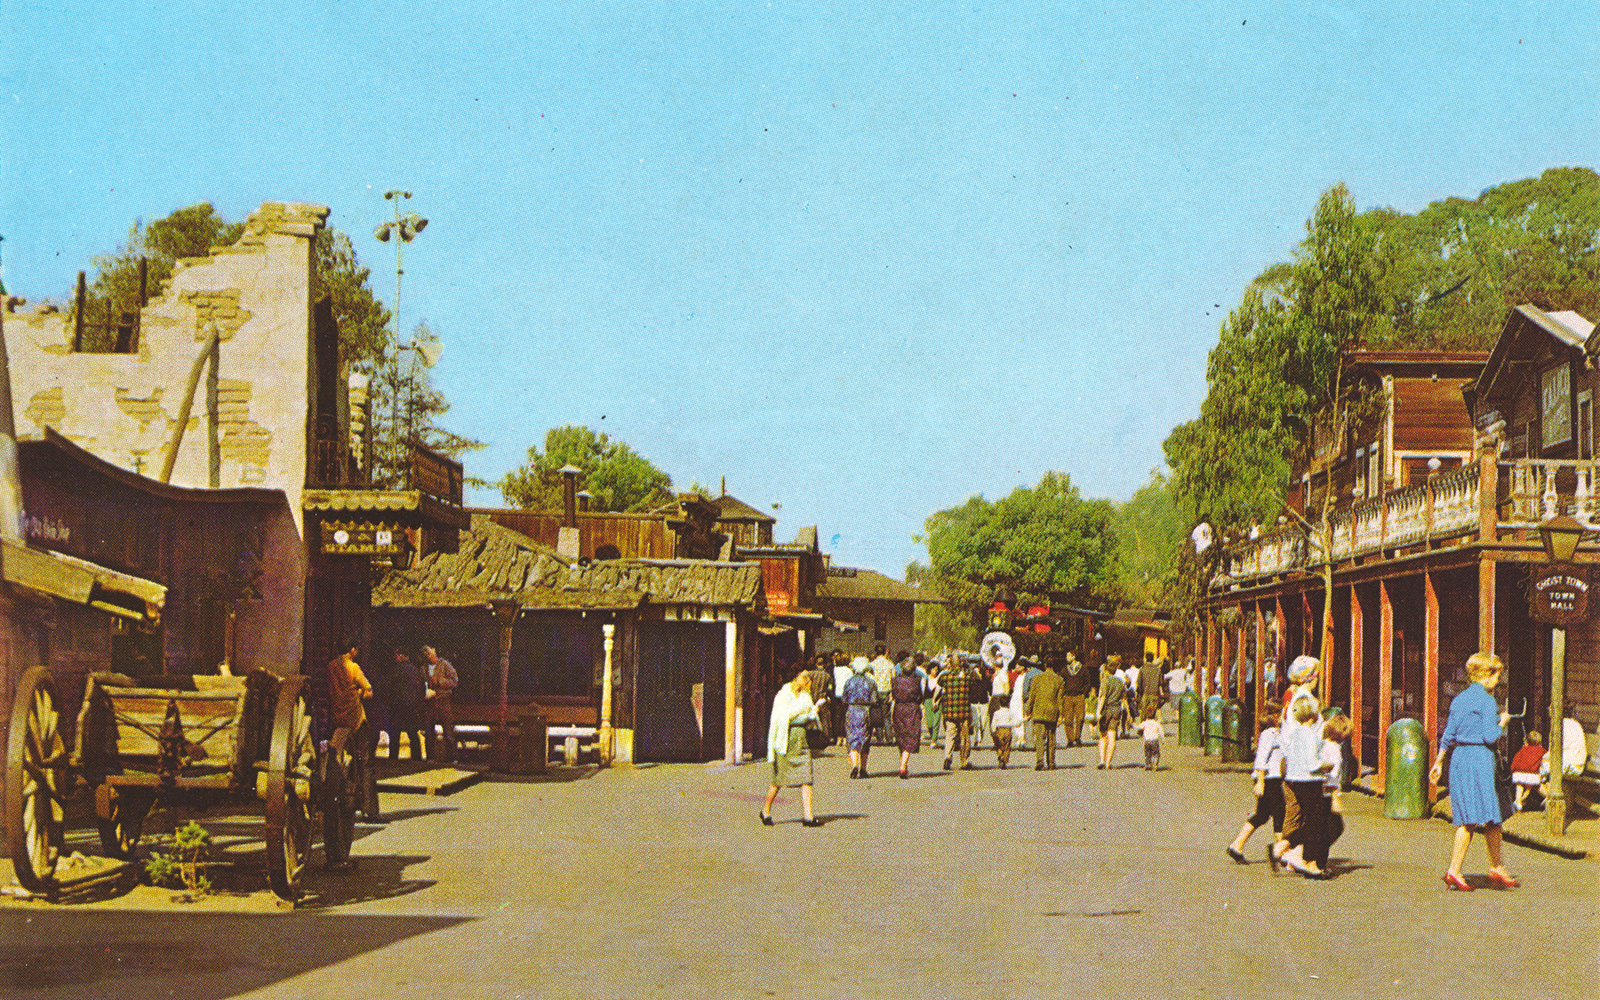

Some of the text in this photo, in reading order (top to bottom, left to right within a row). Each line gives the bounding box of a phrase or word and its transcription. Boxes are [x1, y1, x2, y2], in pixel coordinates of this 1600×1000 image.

[1535, 575, 1589, 592] GHOST TOWN
[1549, 592, 1575, 600] TOWN
[1550, 602, 1574, 610] HALL
